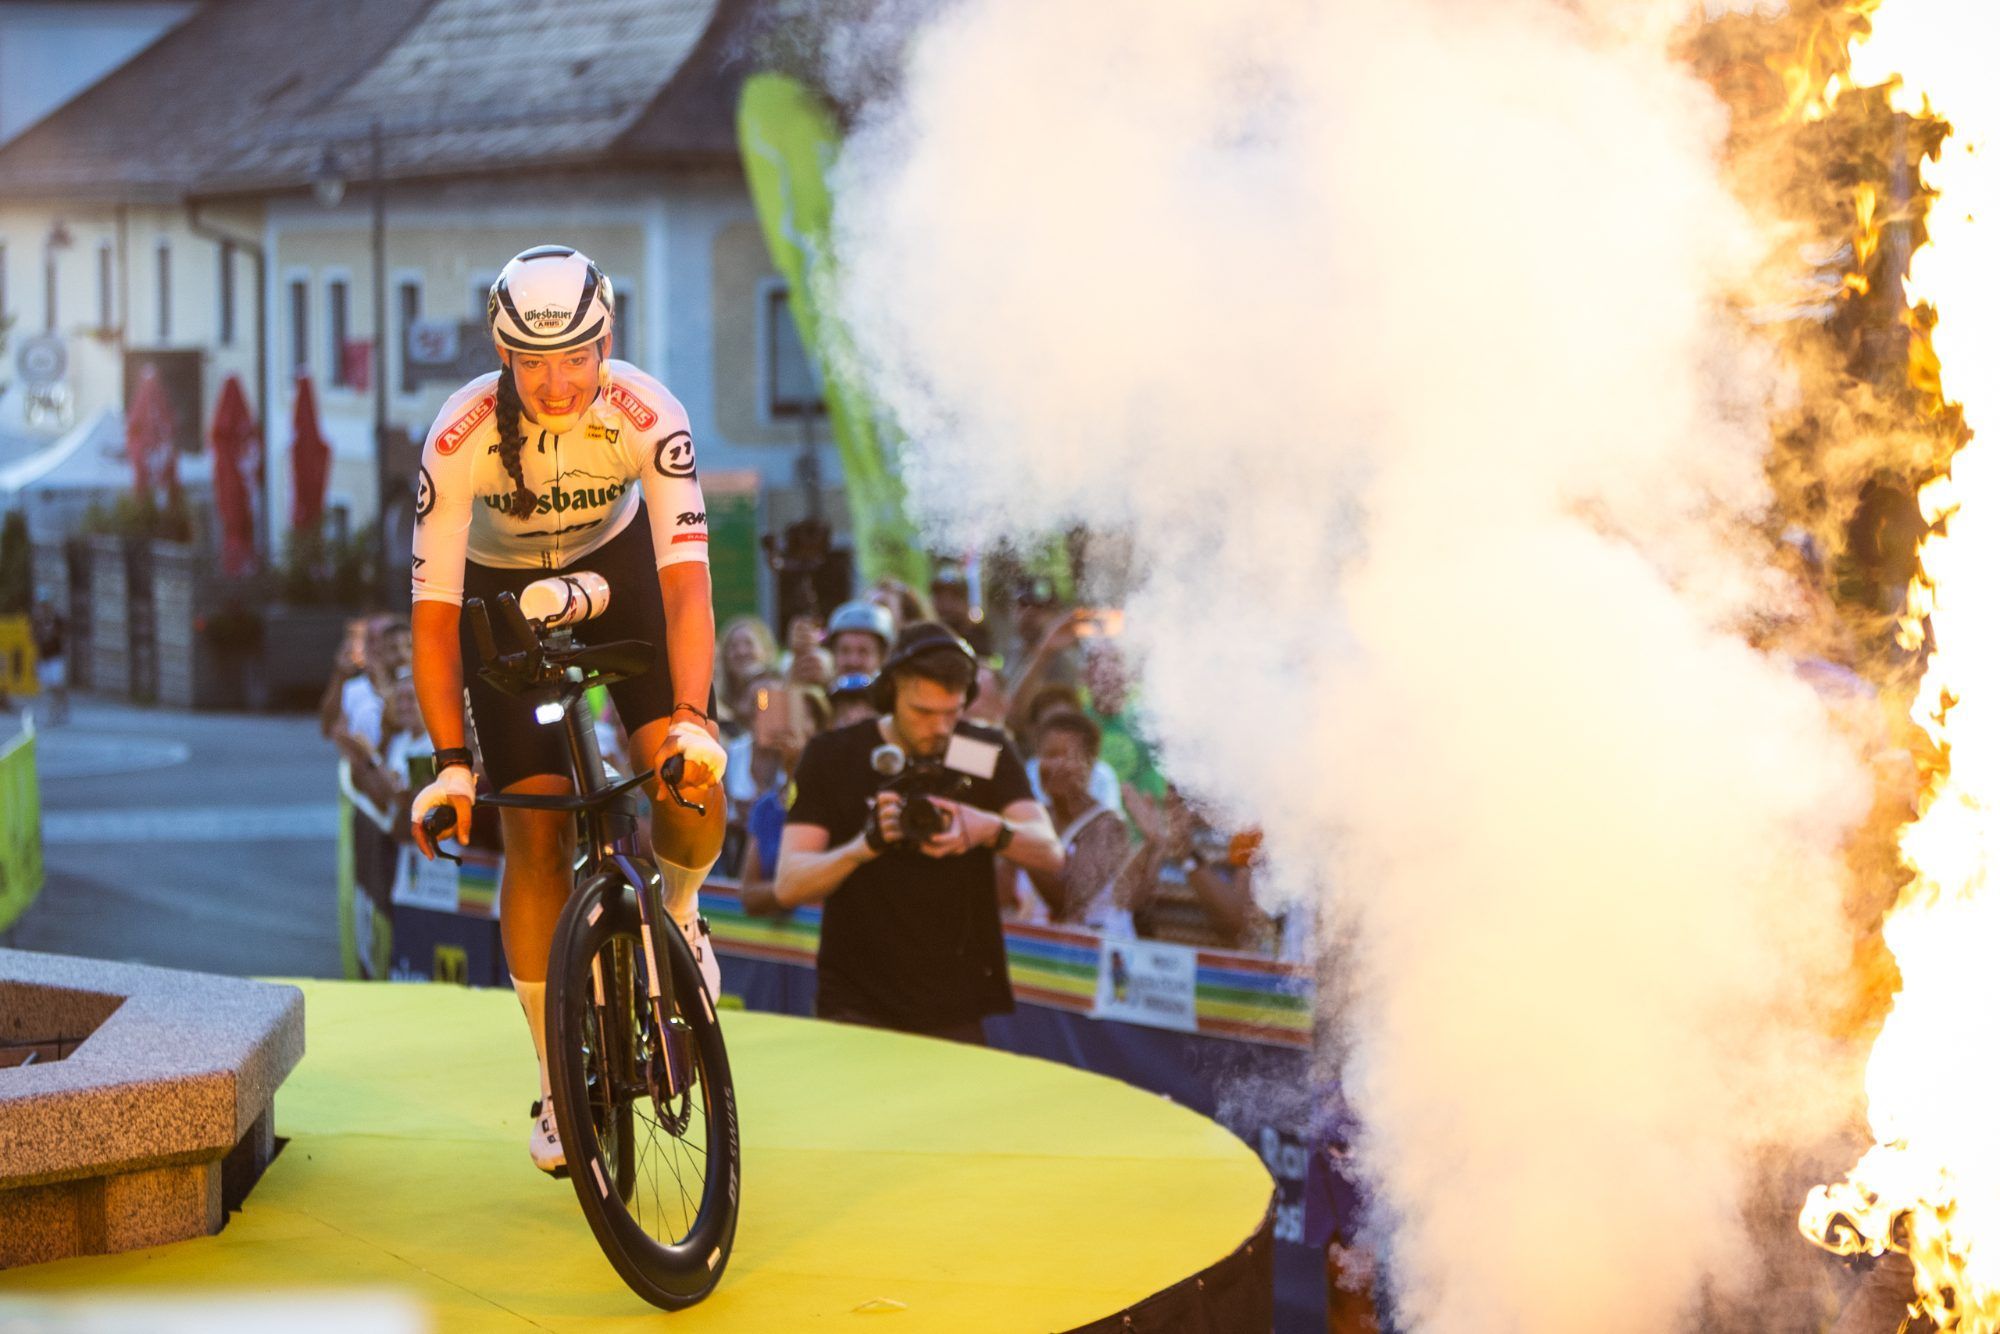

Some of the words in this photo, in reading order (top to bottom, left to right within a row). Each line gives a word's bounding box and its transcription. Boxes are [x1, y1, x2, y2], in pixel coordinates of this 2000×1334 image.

[524, 308, 572, 321] Wiesbauer
[444, 400, 490, 448] ABUS
[611, 388, 651, 425] ABUS
[724, 1086, 738, 1157] SWISS
